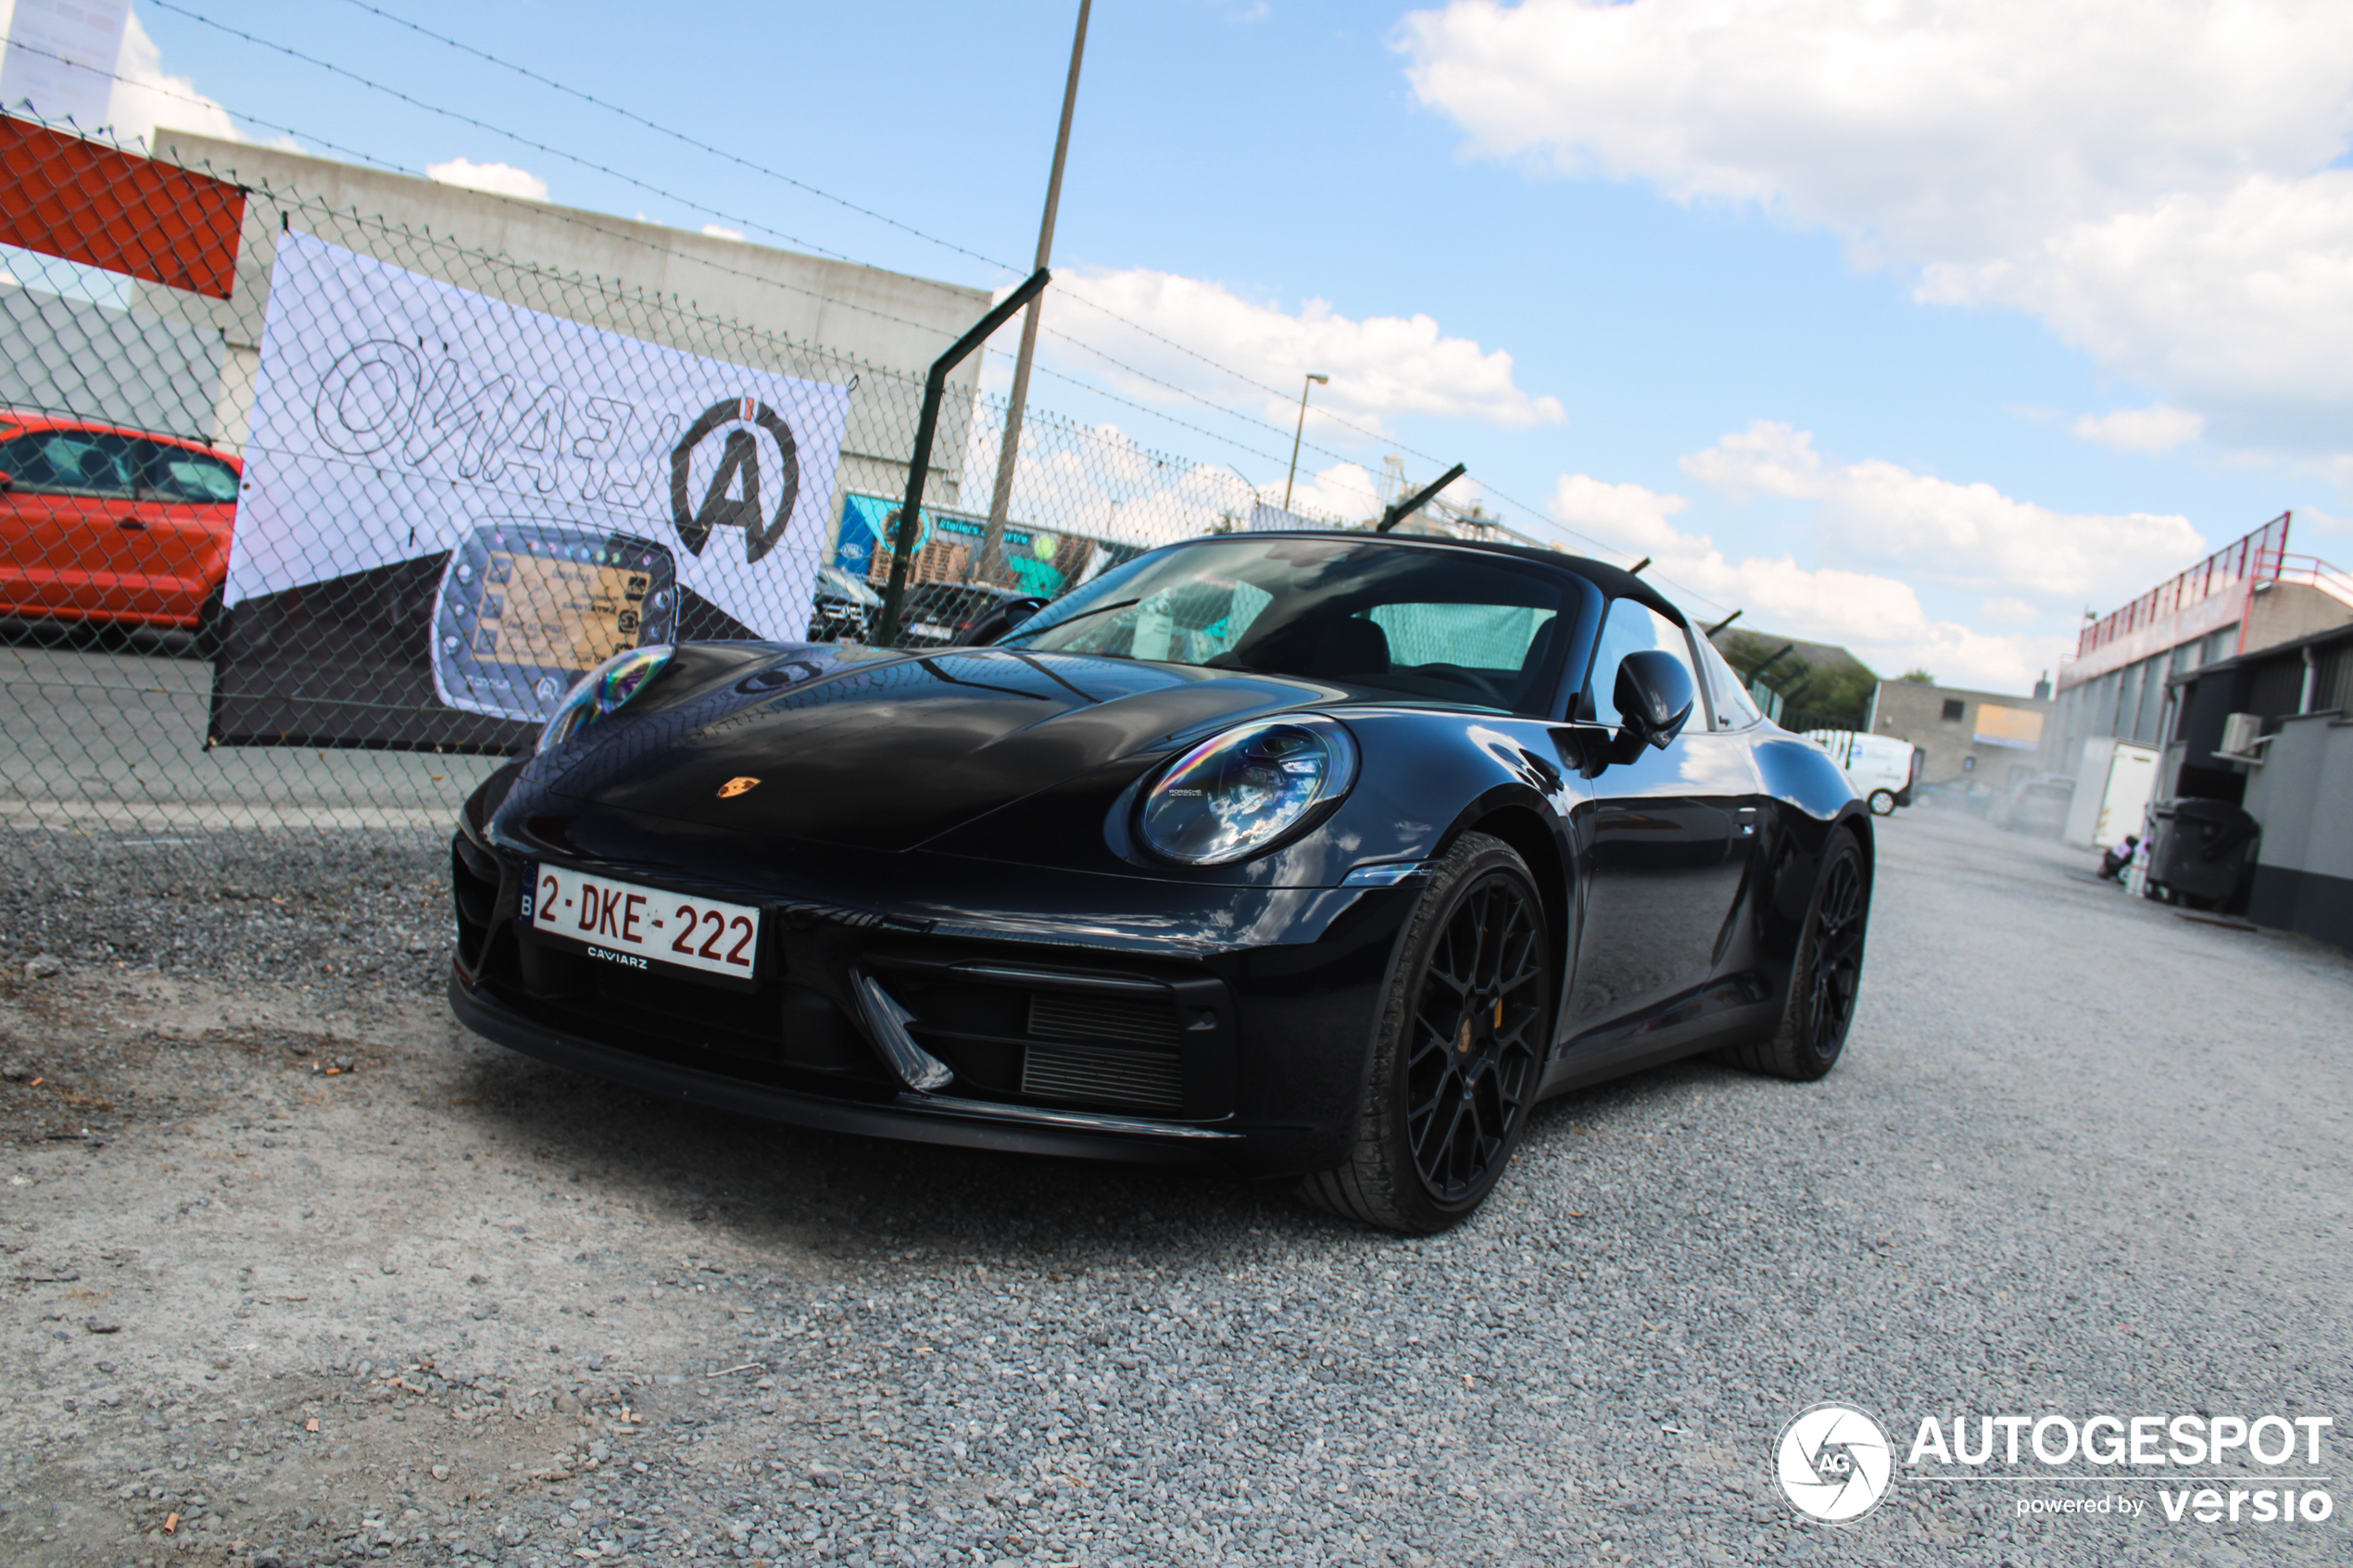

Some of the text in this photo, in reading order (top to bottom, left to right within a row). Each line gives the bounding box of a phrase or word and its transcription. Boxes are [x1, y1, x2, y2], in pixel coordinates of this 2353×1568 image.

[521, 895, 533, 917] B
[538, 874, 755, 968] 2-DKE-222
[586, 946, 648, 971] CAVIARZ
